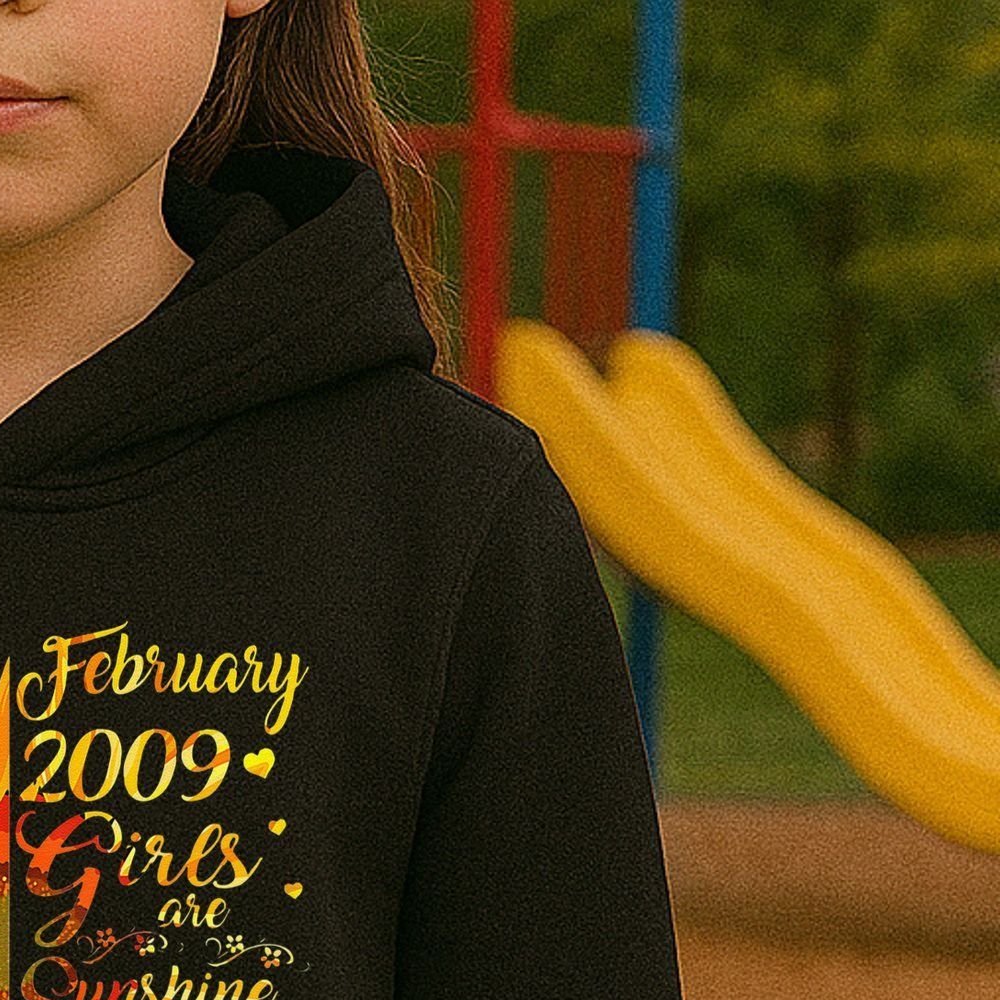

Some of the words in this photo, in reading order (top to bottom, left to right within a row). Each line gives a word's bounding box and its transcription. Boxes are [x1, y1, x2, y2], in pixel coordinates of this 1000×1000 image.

[16, 621, 309, 735] February
[19, 728, 231, 803] 2009
[15, 811, 263, 948] Girls
[157, 893, 230, 929] are
